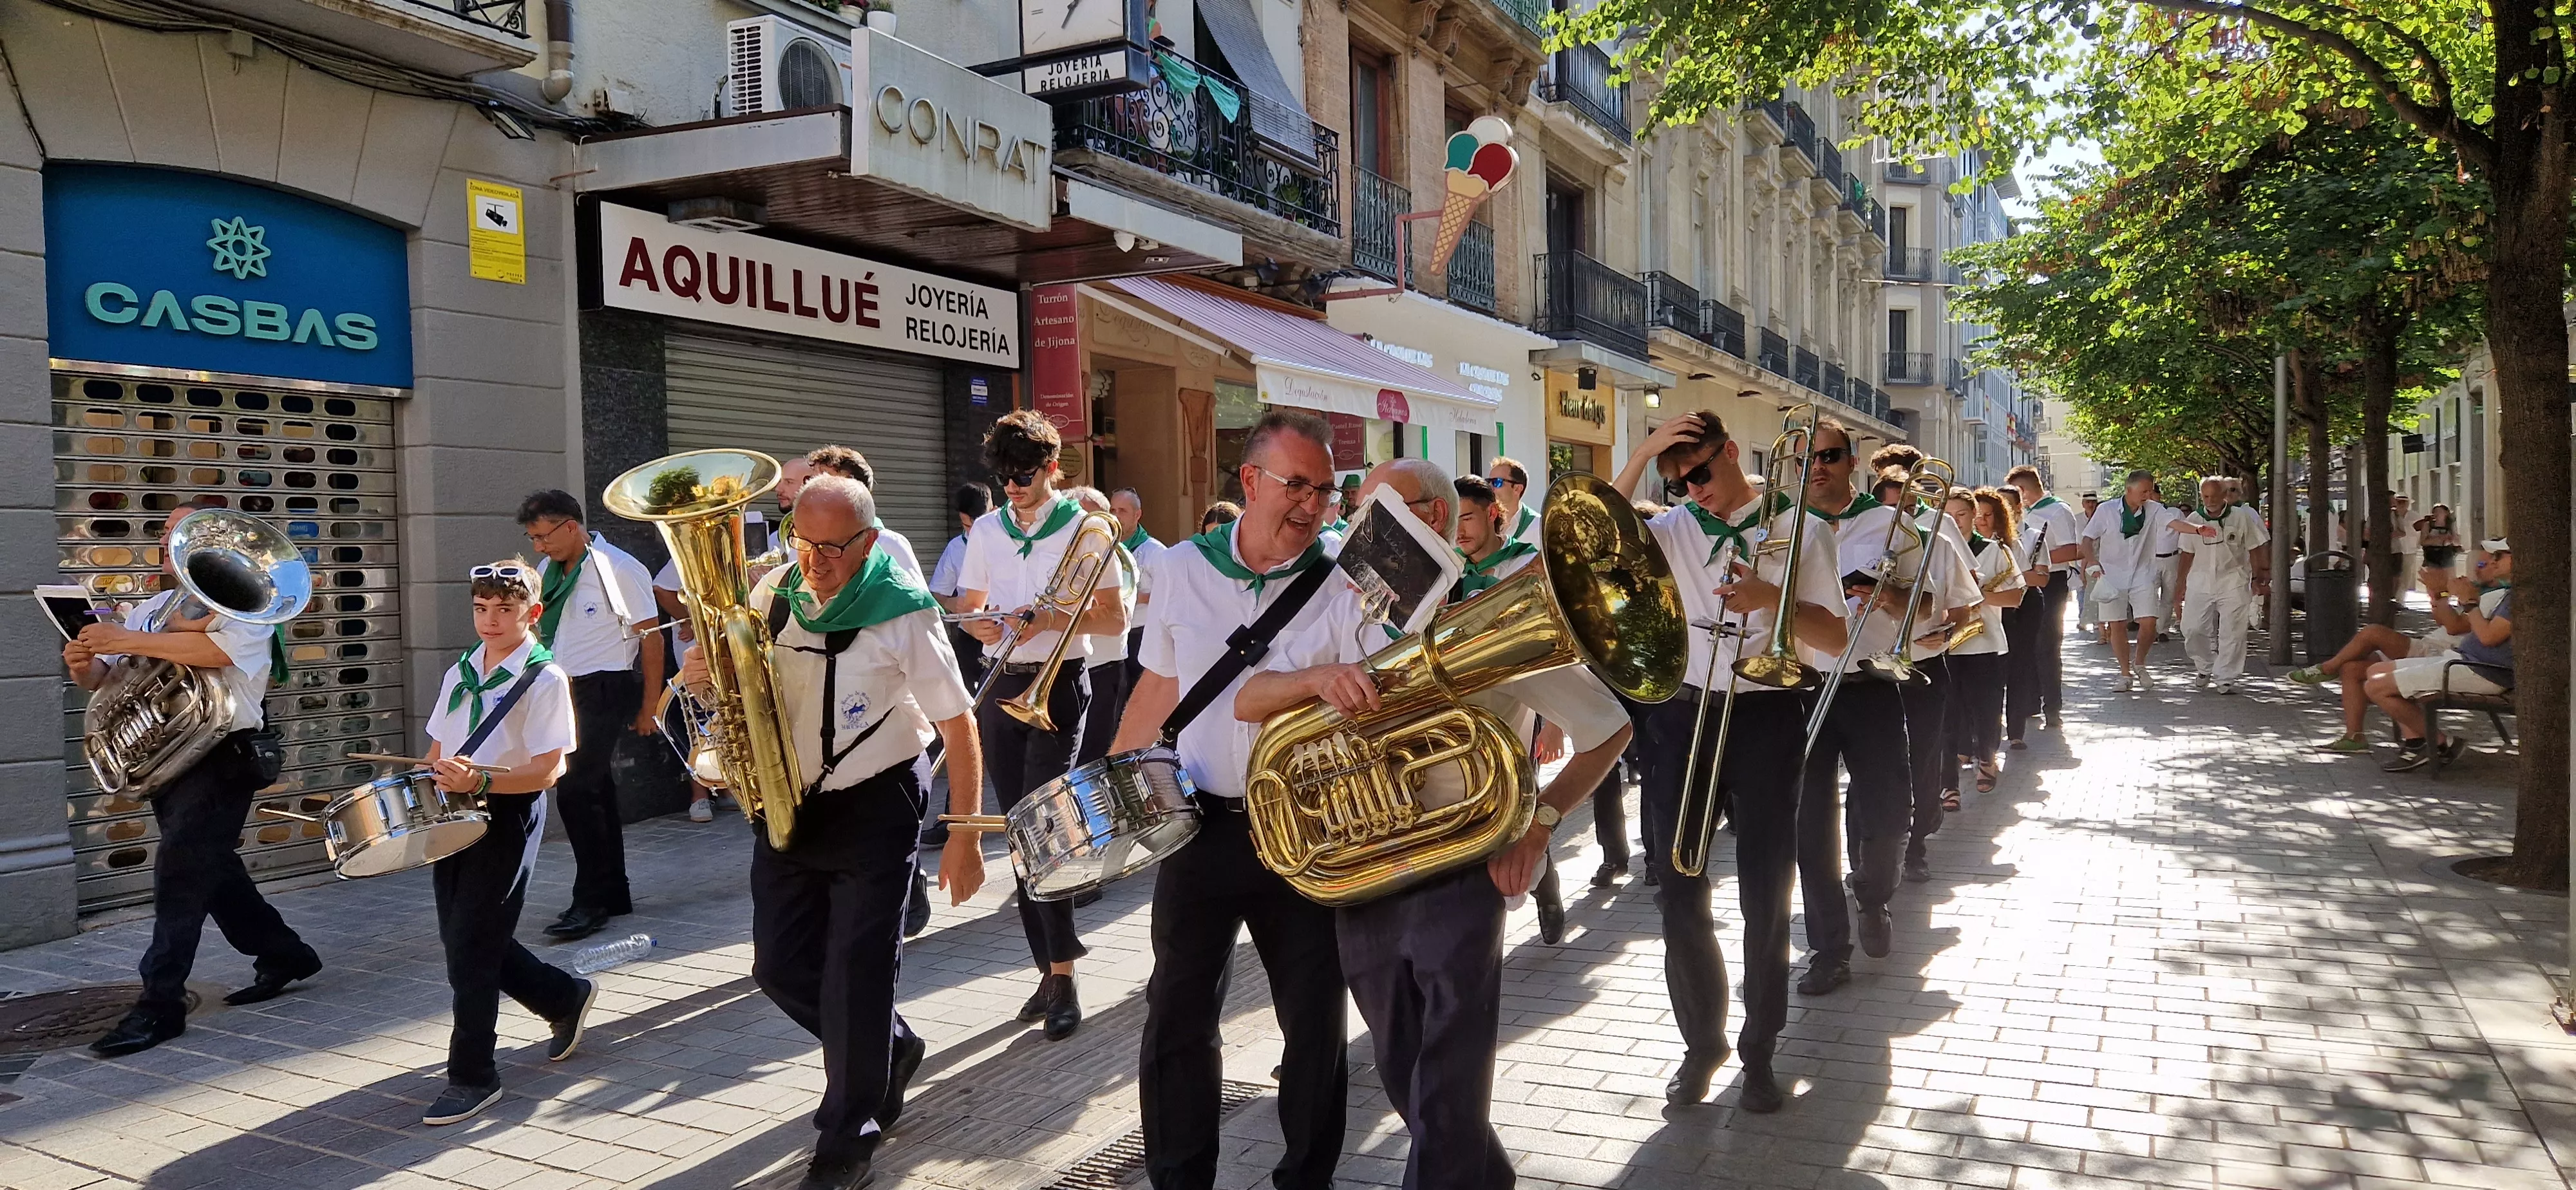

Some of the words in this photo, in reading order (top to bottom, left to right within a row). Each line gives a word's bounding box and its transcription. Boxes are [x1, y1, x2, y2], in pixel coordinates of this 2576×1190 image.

[1048, 55, 1102, 75] JOYERIA
[1041, 69, 1110, 91] RELOJERIA
[876, 84, 1048, 184] CONRAT
[619, 236, 881, 329] AQUILLUÉ
[905, 282, 989, 320] JOYERÍA
[1037, 292, 1068, 304] Turrón
[85, 281, 379, 350] CASBAS
[1034, 316, 1075, 326] Artesano
[905, 317, 1010, 356] RELOJERÍA
[1034, 338, 1046, 347] de
[1047, 336, 1075, 349] Jijona
[1283, 376, 1328, 402] Degustación
[1560, 390, 1582, 419] Fleur
